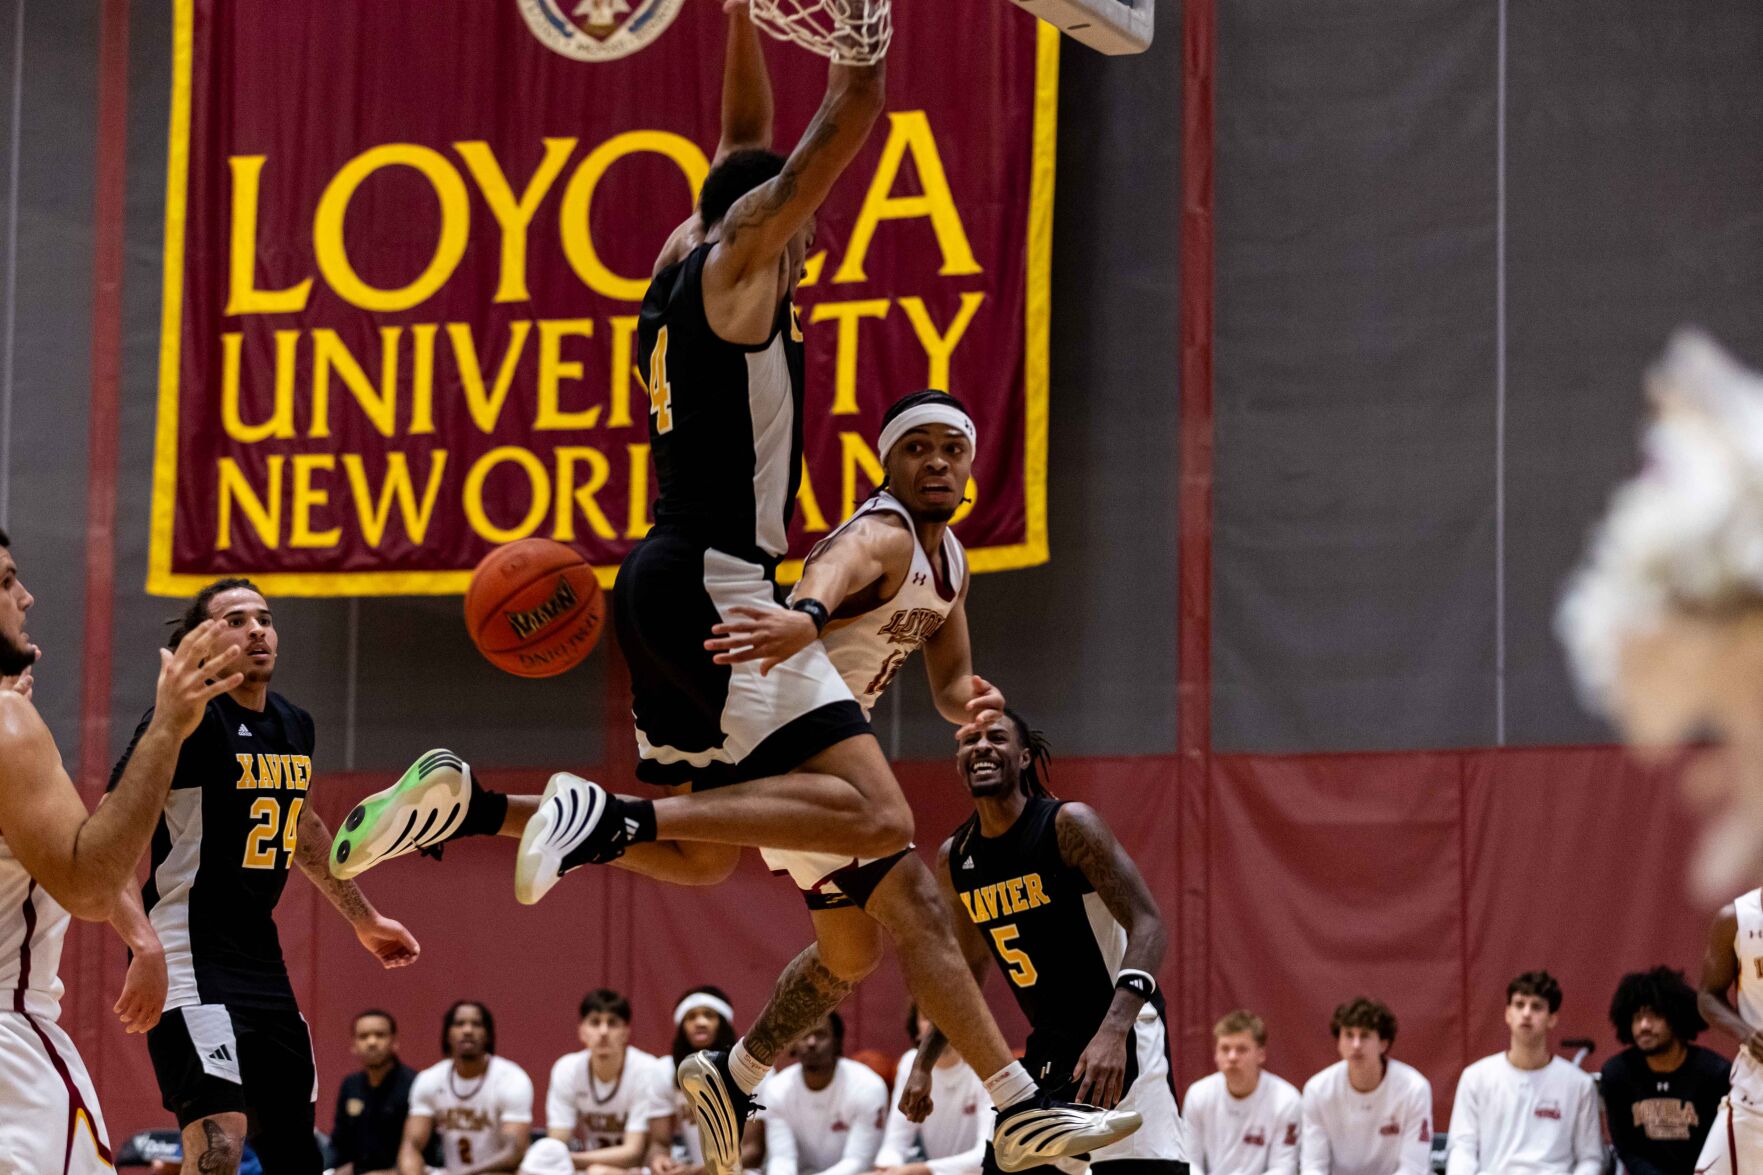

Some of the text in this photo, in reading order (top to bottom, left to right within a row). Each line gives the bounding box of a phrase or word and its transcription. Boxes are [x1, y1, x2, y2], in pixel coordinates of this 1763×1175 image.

[225, 109, 984, 316] LOYOA
[219, 290, 987, 443] UNIVERTY
[650, 324, 674, 436] 4
[216, 445, 448, 551] NEW
[235, 753, 312, 791] XAVIER
[241, 796, 305, 870] 24
[989, 923, 1038, 988] 5
